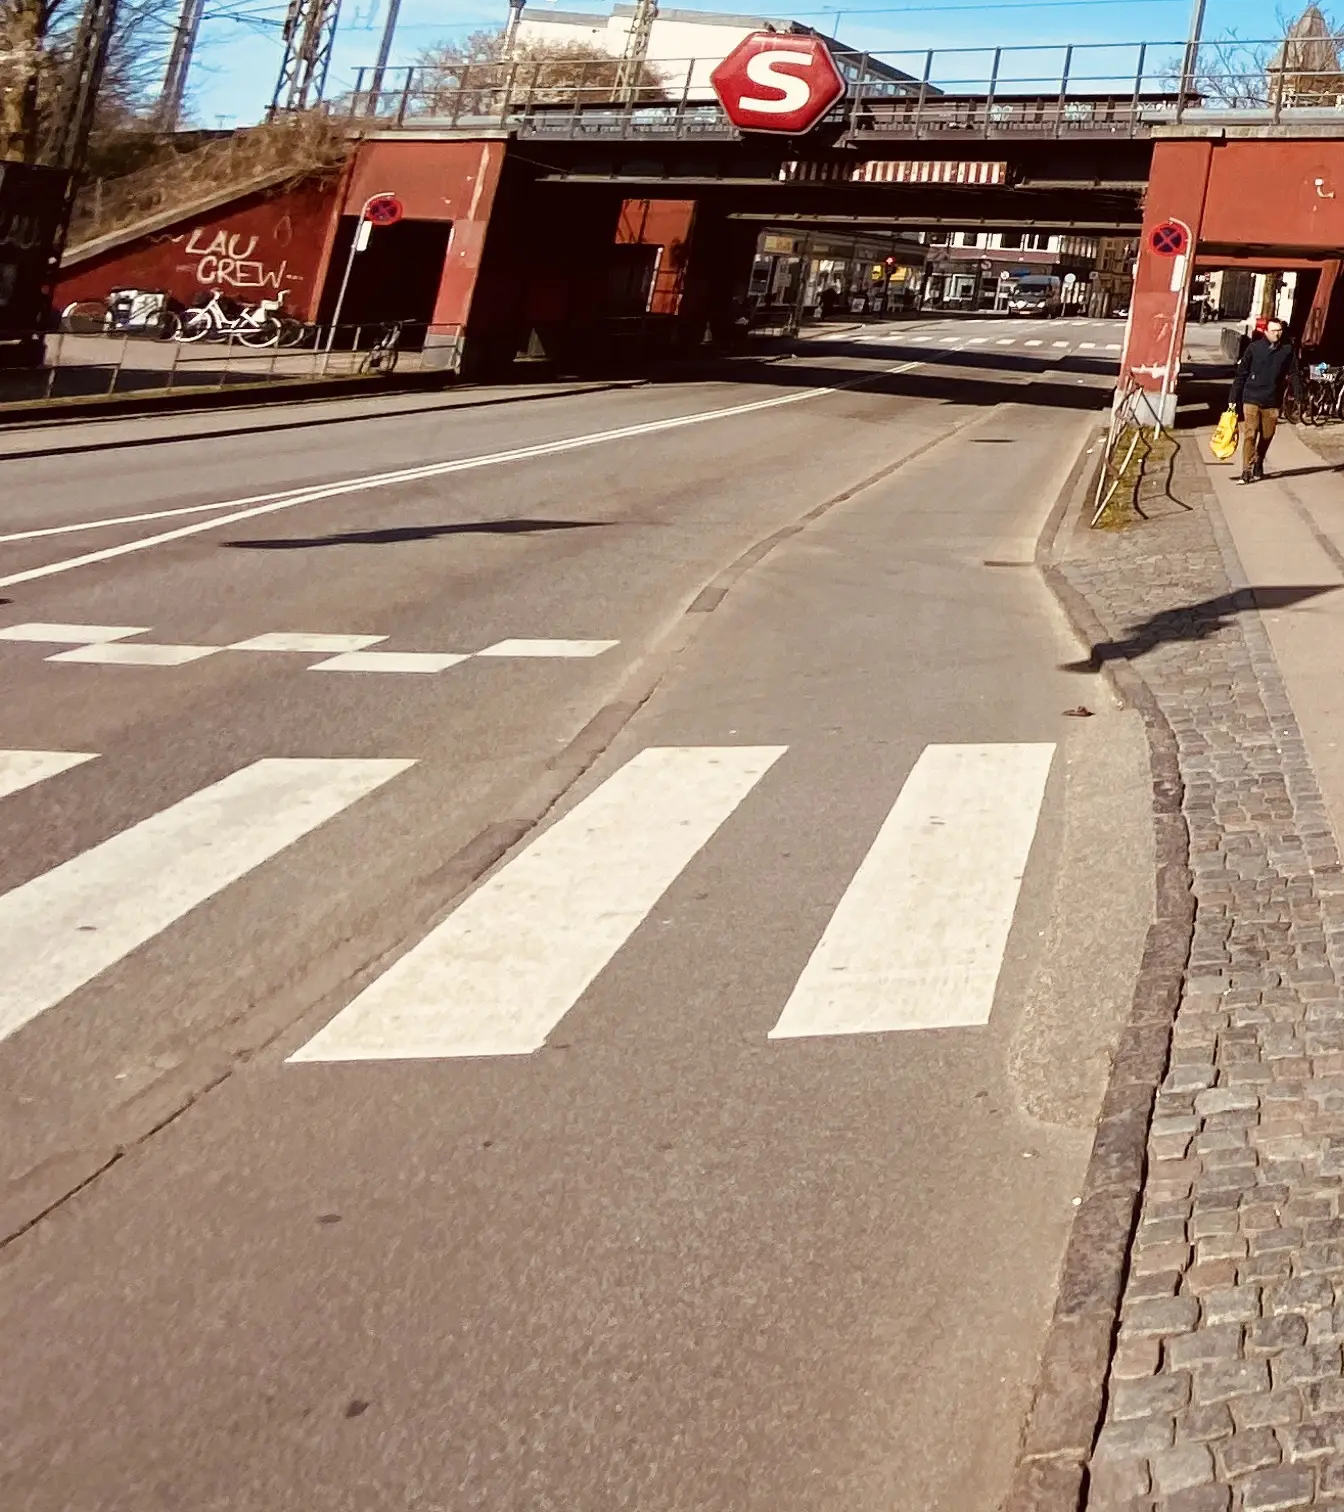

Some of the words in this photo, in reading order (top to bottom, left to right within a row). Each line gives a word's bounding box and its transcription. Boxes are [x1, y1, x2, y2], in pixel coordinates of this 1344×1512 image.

[738, 50, 814, 114] S
[186, 227, 259, 259] LAU
[197, 255, 287, 288] CREW
